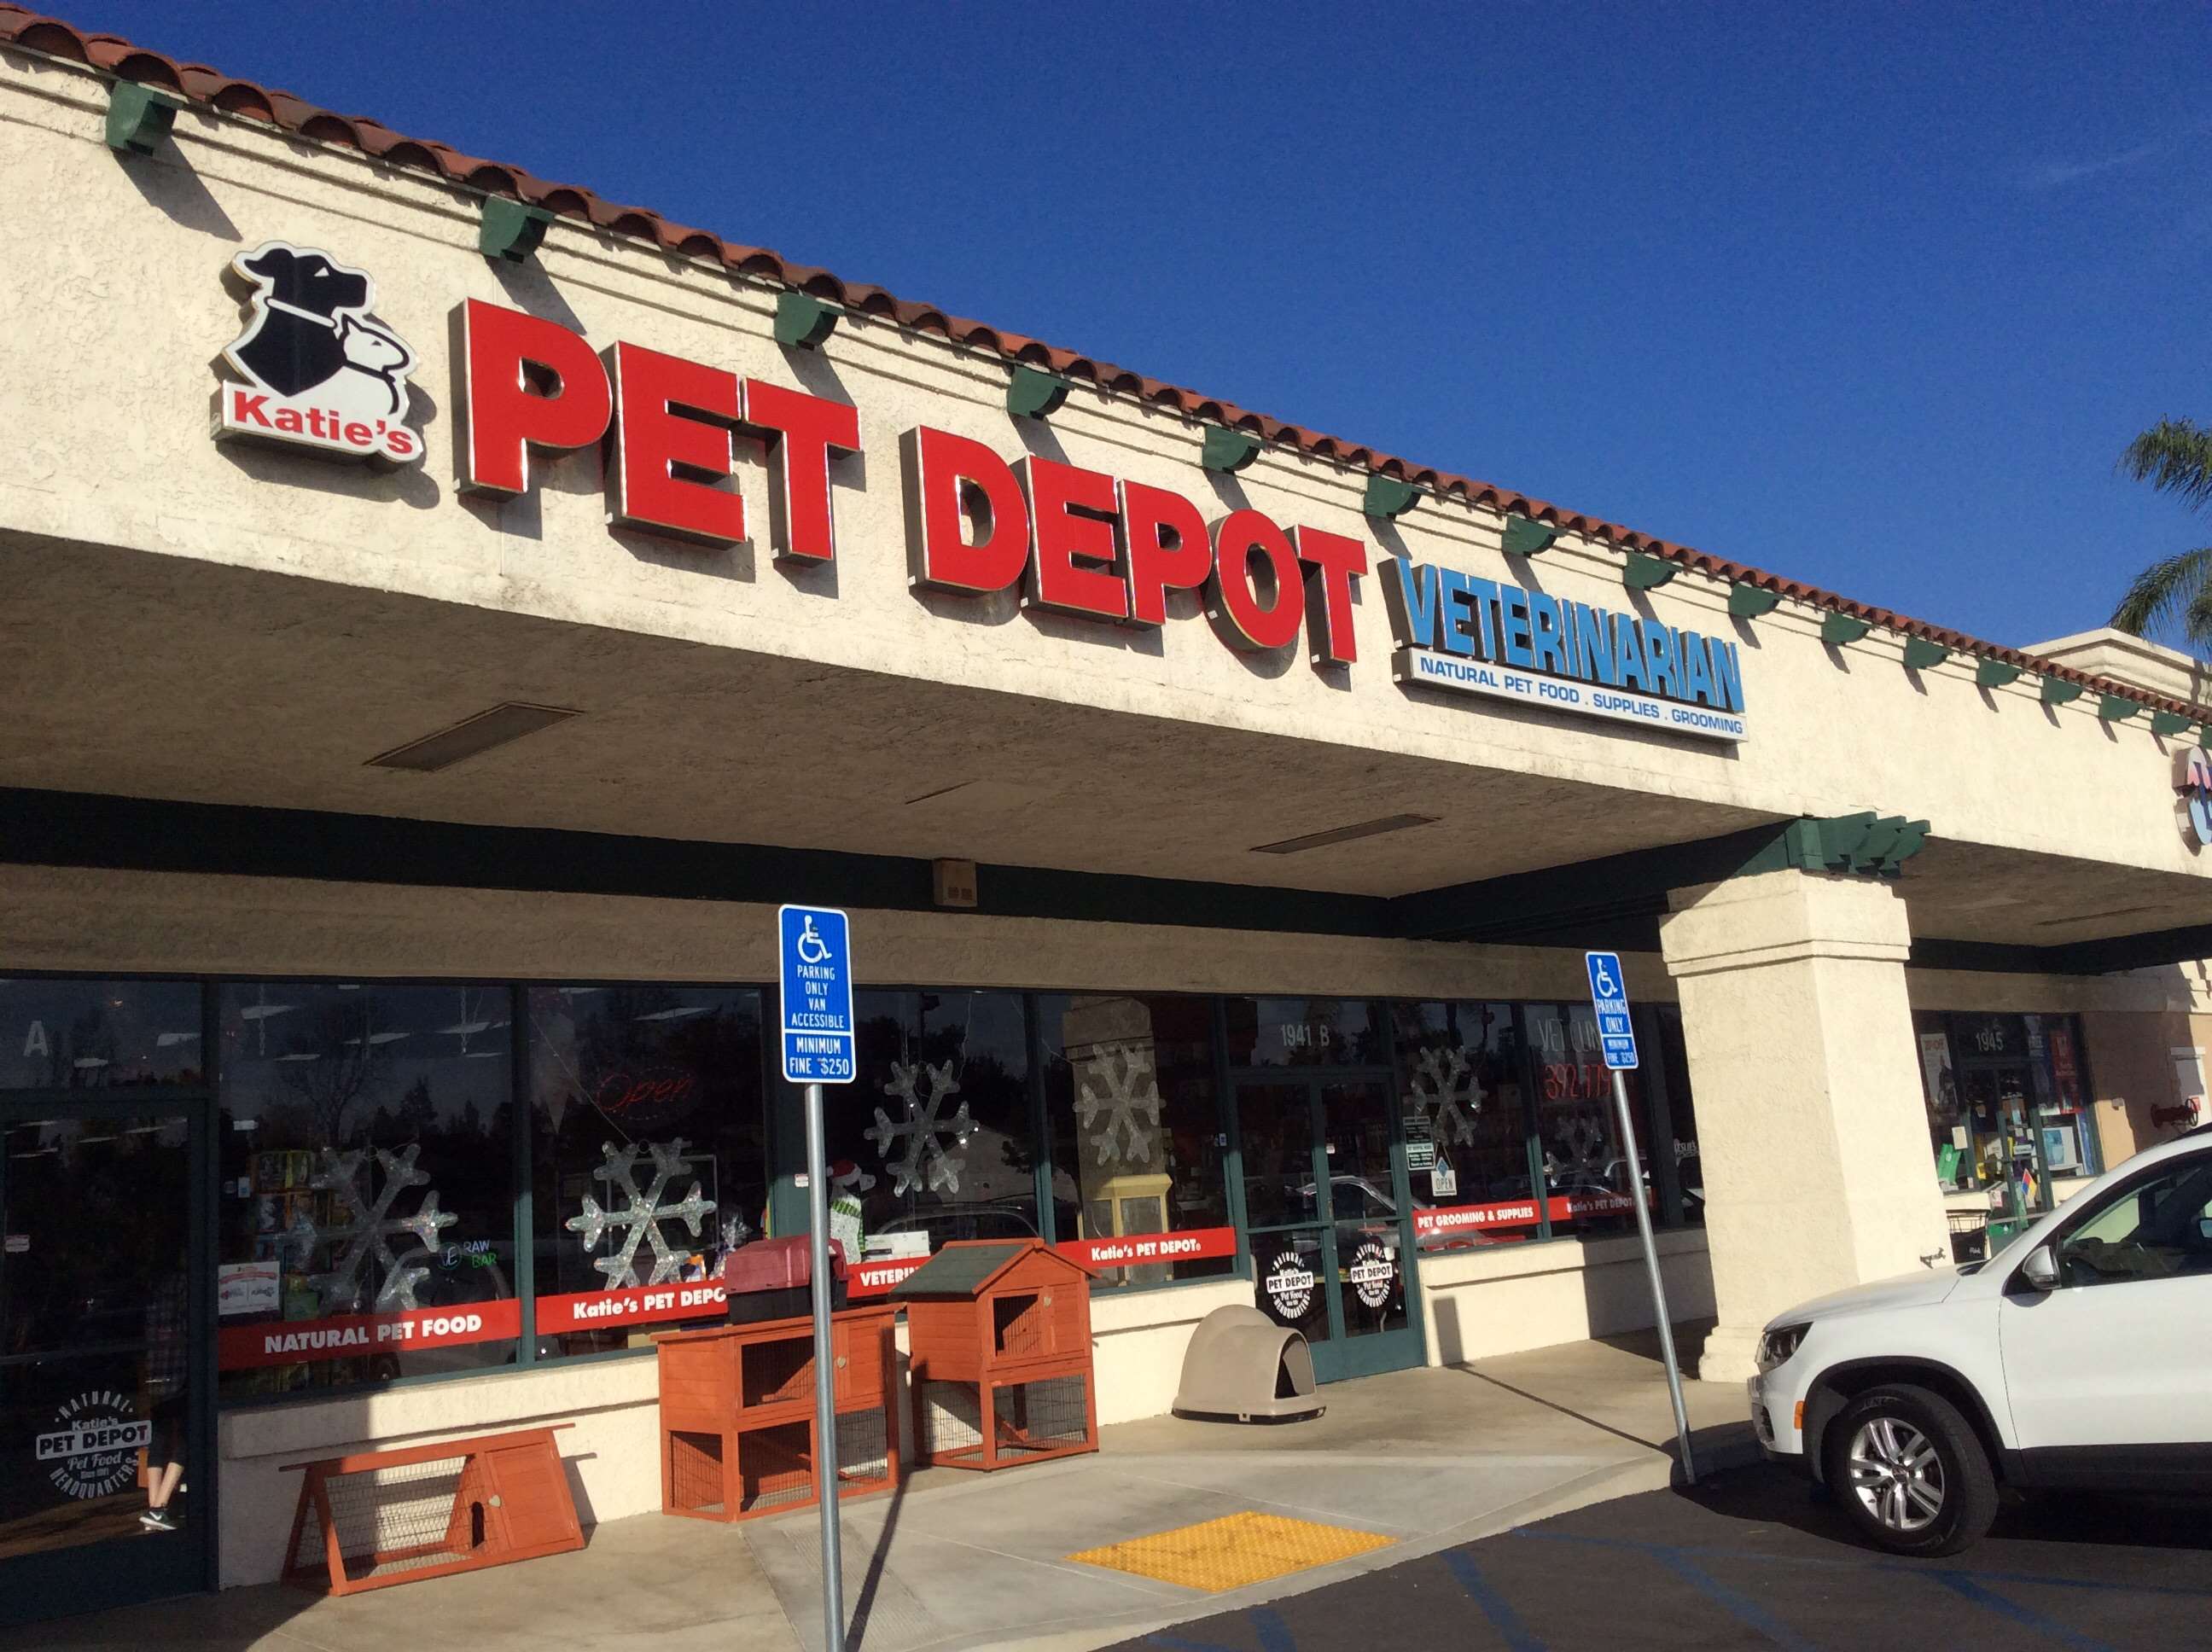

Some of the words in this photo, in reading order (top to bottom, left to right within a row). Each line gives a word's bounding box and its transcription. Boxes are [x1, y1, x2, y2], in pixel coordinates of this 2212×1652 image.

[234, 390, 413, 454] Katie's
[461, 296, 863, 561] PET
[913, 425, 1368, 665] DEPOT
[1394, 556, 1746, 713] VETERINARIAN
[1420, 657, 1499, 688] NATURAL
[1505, 675, 1533, 694] PET
[1539, 683, 1580, 703] FOOD
[1592, 694, 1660, 718] SUPPLIES
[1671, 709, 1743, 734] GROOMING
[797, 964, 835, 980] PARKING
[805, 981, 829, 996] ONLY
[808, 998, 826, 1011] VAN
[1597, 998, 1627, 1015] PARKING
[791, 1013, 845, 1028] ACCESSIBLE
[1605, 1017, 1623, 1033] ONLY
[23, 1020, 49, 1057] A
[1280, 1023, 1312, 1047] 1941
[1319, 1024, 1330, 1047] B
[1570, 1019, 1603, 1052] CLIN
[1976, 1031, 2005, 1052] 1945
[796, 1037, 841, 1054] MINIMUM
[789, 1057, 812, 1074] FINE
[819, 1056, 849, 1075] $250
[1594, 1199, 1609, 1210] PET
[1417, 1216, 1434, 1229] PET
[1435, 1211, 1485, 1226] GROOMING
[1487, 1210, 1495, 1222] &
[1497, 1207, 1534, 1221] SUPPLIES
[463, 1238, 492, 1254] RAW
[1091, 1244, 1133, 1261] Katie's
[1136, 1242, 1156, 1257] PET
[1160, 1238, 1197, 1254] DEPOT
[472, 1252, 498, 1269] BAR
[1268, 1279, 1283, 1290] PET
[1285, 1275, 1312, 1288] DEPOT
[1352, 1269, 1365, 1281] PET
[1367, 1265, 1392, 1277] DEPOT
[573, 1296, 638, 1320] Katie's
[643, 1292, 675, 1312] PET
[680, 1287, 726, 1307] DEPO
[265, 1326, 370, 1353] NATURAL
[377, 1322, 415, 1342] PET
[422, 1315, 482, 1337] FOOD
[58, 1390, 131, 1419] NATURAL
[72, 1416, 119, 1432] Katie's
[39, 1435, 75, 1456] PET
[82, 1424, 148, 1449] DEPOT
[68, 1456, 88, 1471] Pet
[91, 1451, 122, 1468] Food
